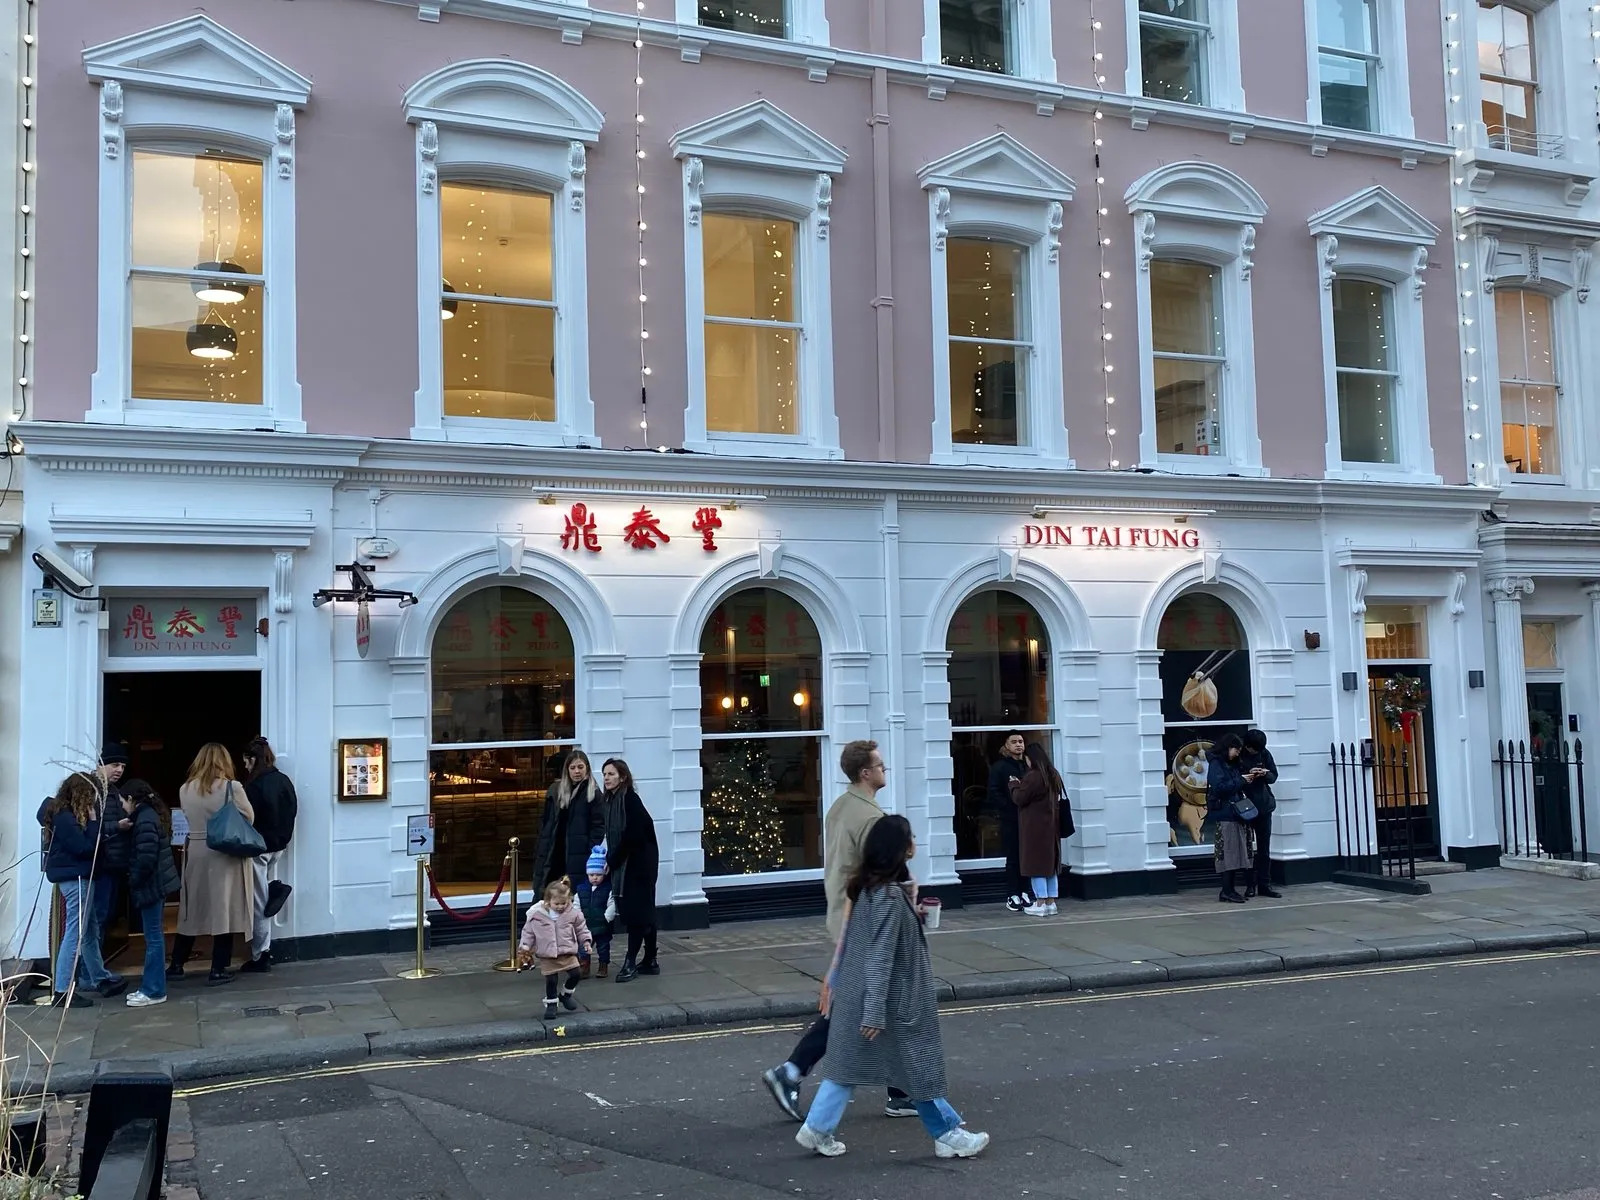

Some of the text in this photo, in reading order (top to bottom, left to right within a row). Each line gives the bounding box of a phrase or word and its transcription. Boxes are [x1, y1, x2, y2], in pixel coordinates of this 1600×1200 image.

[560, 502, 722, 552] 鼎泰豐
[1023, 524, 1200, 548] DIN TAI FUNG
[122, 604, 242, 640] 鼎泰豐
[134, 641, 232, 651] DIN TAI FUNG
